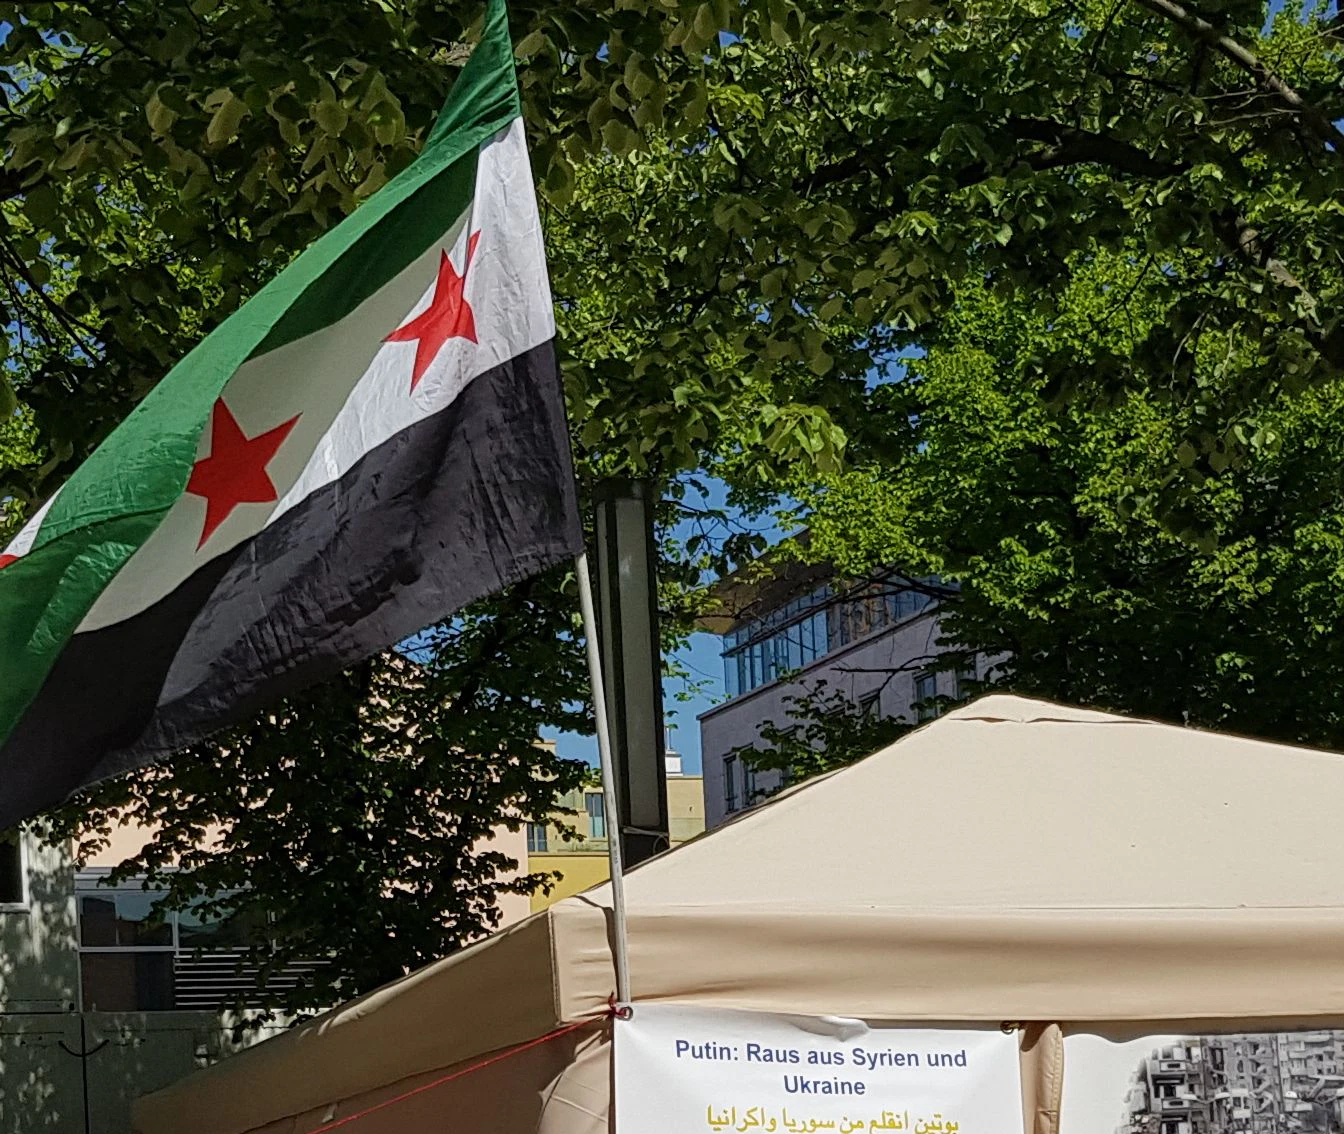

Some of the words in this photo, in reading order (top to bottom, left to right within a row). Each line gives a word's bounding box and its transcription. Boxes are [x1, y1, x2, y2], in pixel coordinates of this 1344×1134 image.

[676, 1040, 738, 1061] Putin:
[746, 1044, 800, 1064] Raus
[807, 1050, 844, 1065] aus
[852, 1048, 920, 1070] Syrien
[927, 1050, 967, 1067] und
[784, 1075, 866, 1095] Ukraine
[782, 1107, 835, 1134] سوريا
[840, 1117, 864, 1134] من
